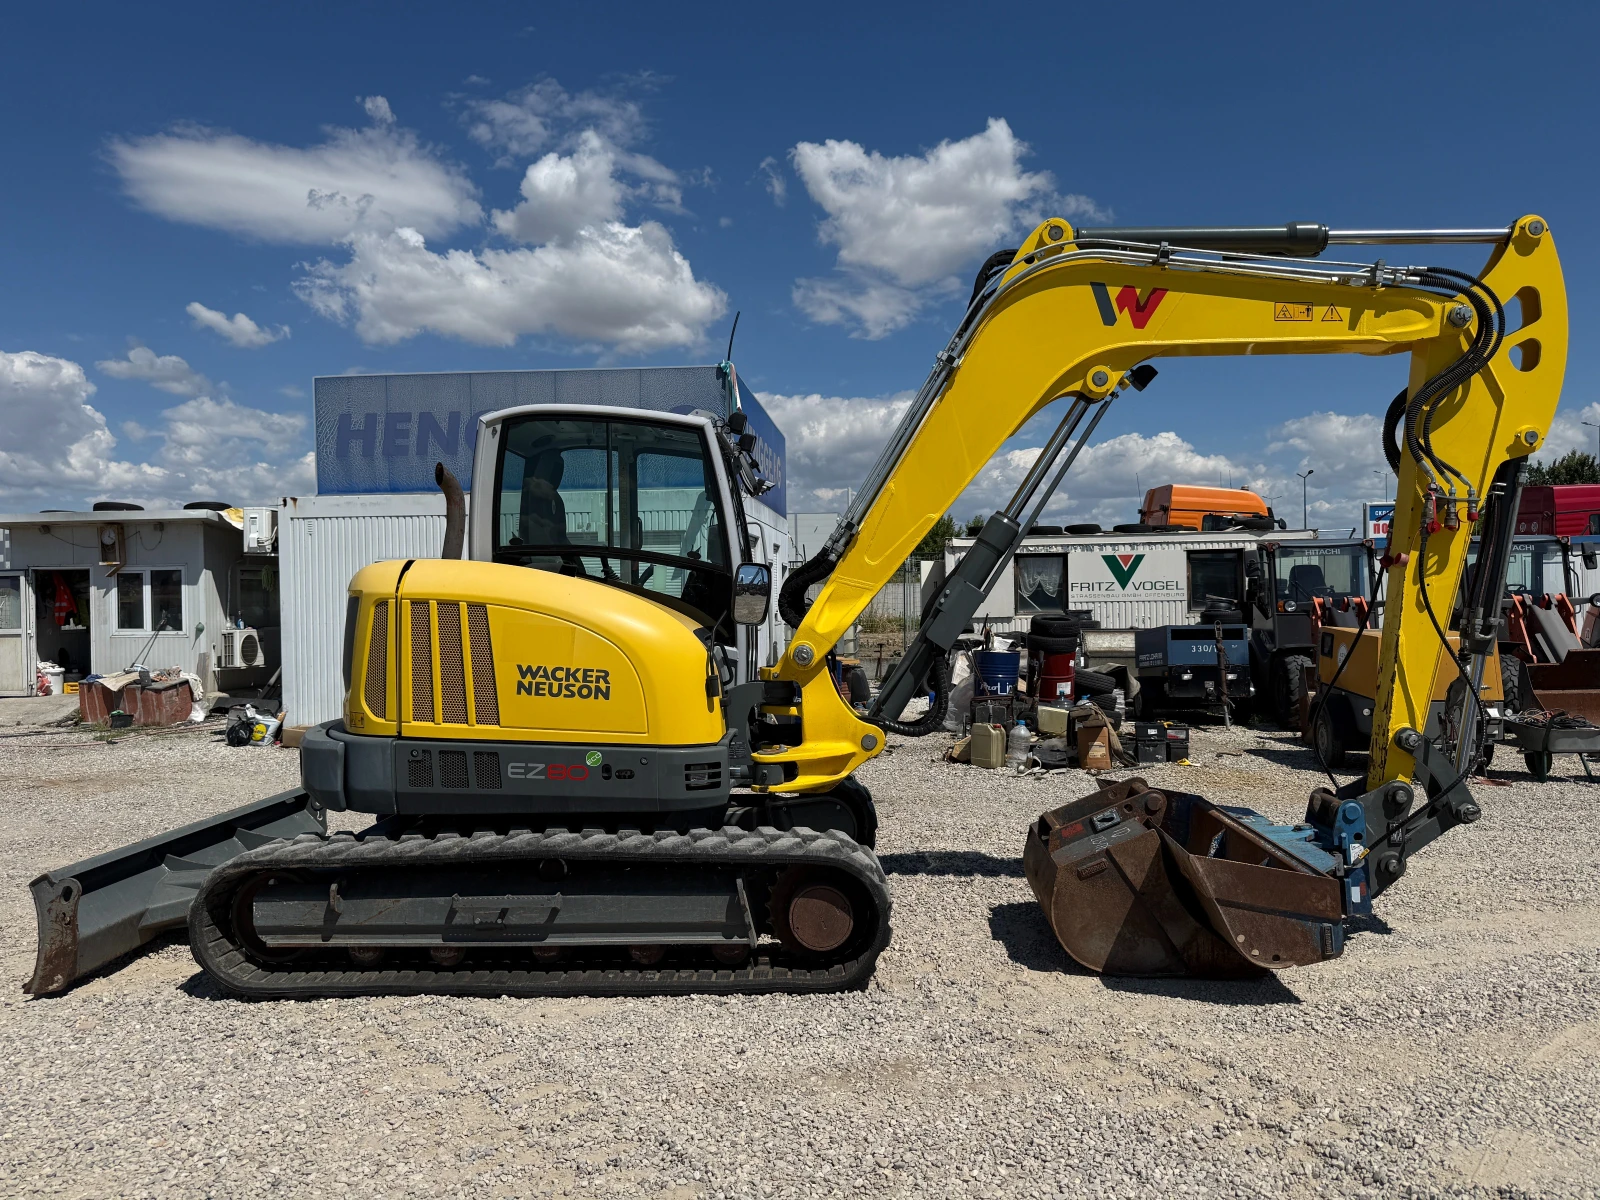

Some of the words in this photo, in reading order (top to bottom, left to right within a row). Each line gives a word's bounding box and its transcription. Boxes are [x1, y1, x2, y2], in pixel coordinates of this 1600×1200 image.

[335, 409, 480, 457] HEN
[1305, 548, 1341, 556] HITACHI
[1070, 581, 1116, 592] FRITZ
[1132, 580, 1185, 591] VOGEL
[516, 664, 610, 685] WACKER
[516, 680, 610, 700] NEUSON
[507, 762, 589, 781] EZ80
